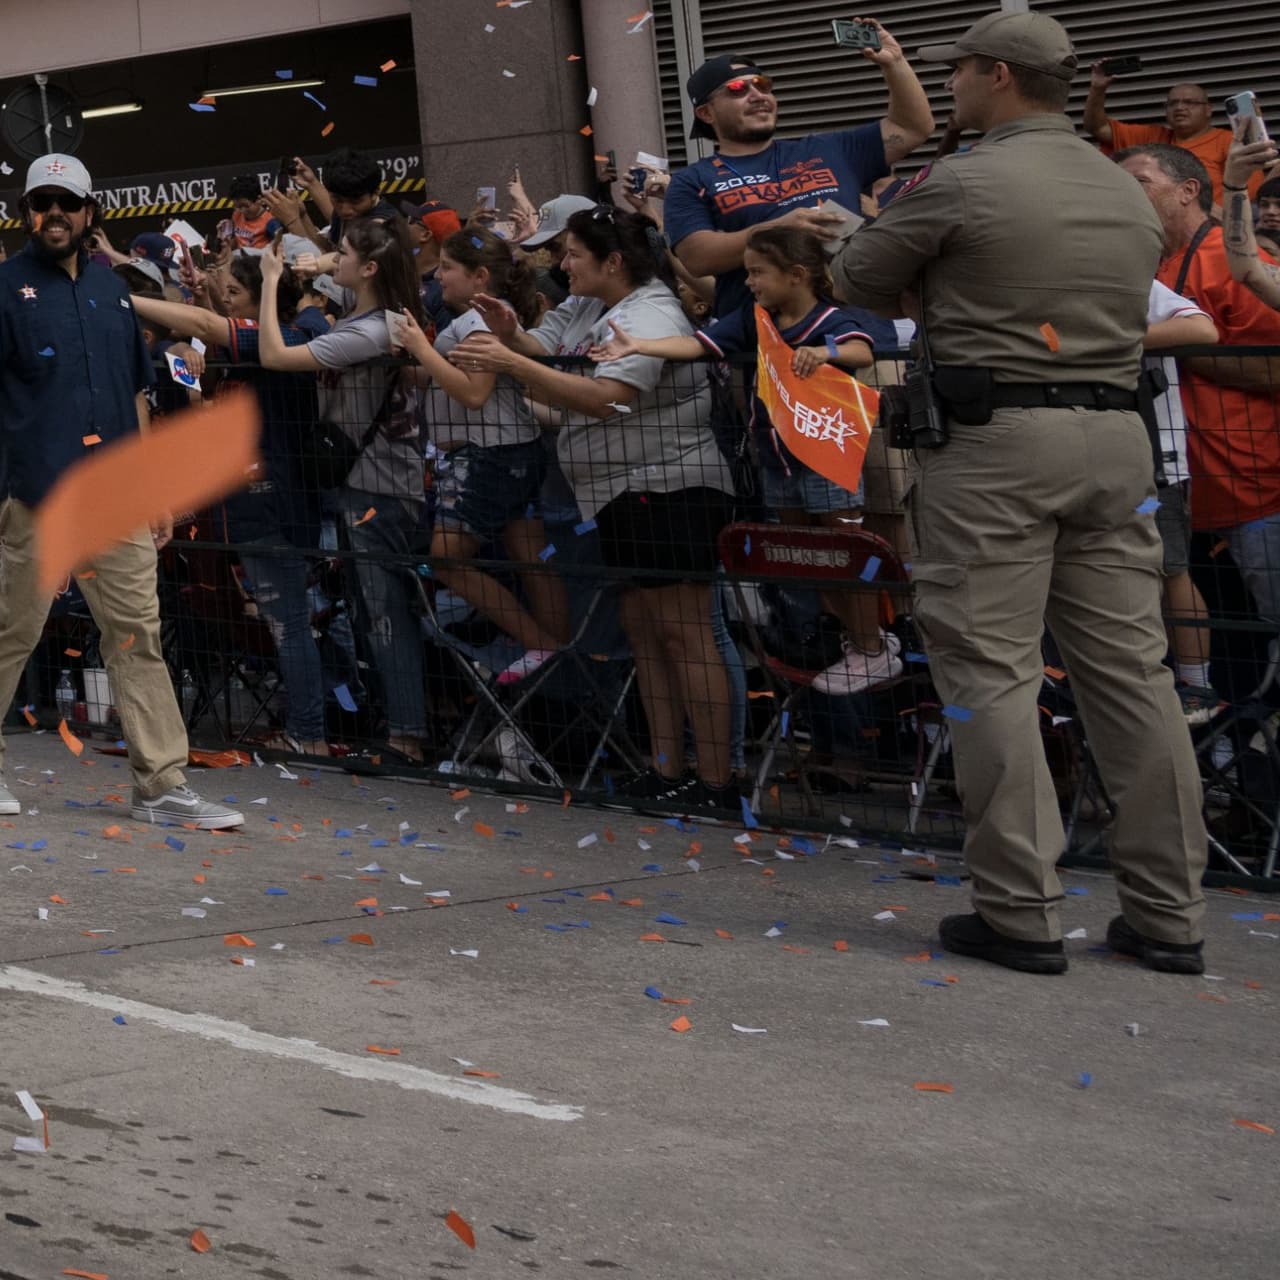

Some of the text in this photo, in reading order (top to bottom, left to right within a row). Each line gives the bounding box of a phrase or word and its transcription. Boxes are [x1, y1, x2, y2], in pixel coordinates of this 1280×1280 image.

[714, 174, 771, 192] 2022
[719, 171, 834, 209] CHAMPS
[794, 415, 819, 439] UP
